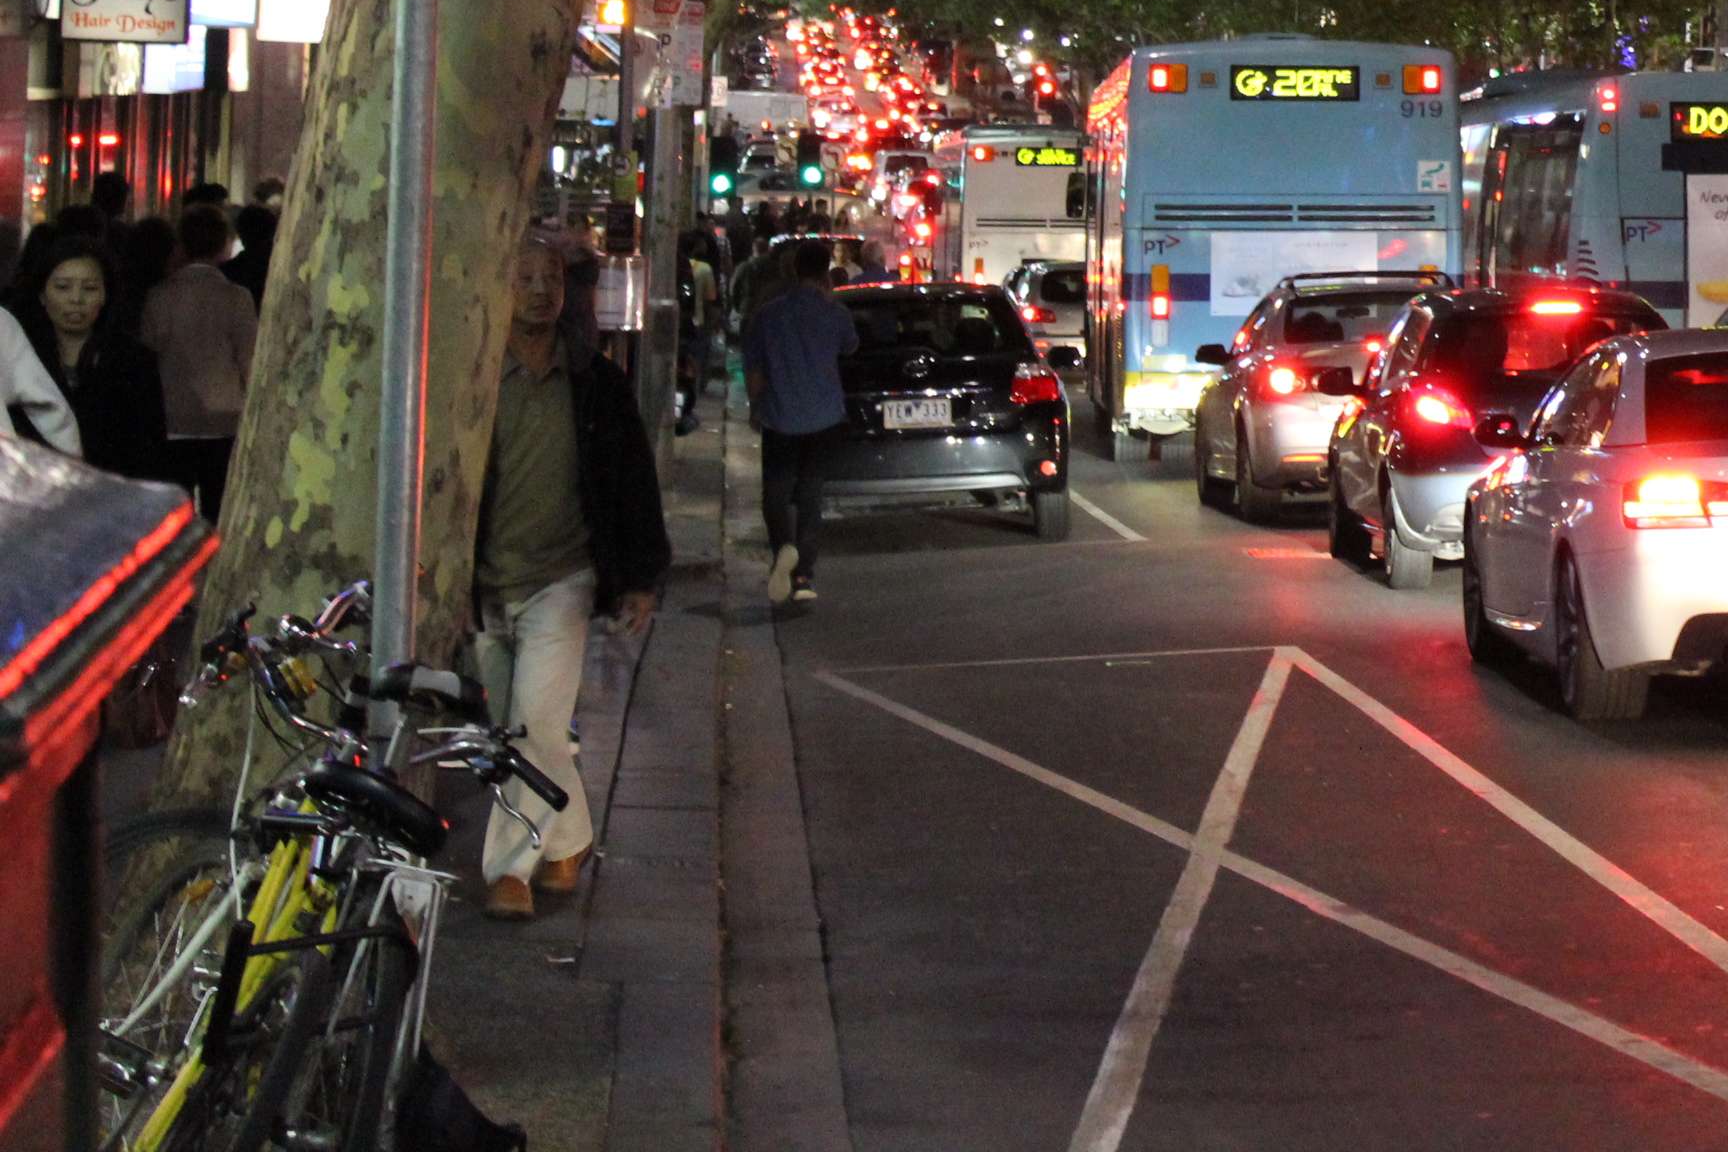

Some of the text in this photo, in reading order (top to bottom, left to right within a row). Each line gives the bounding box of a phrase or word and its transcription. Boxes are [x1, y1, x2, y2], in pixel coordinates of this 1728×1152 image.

[70, 12, 176, 37] Hair Design
[1400, 100, 1443, 118] 919
